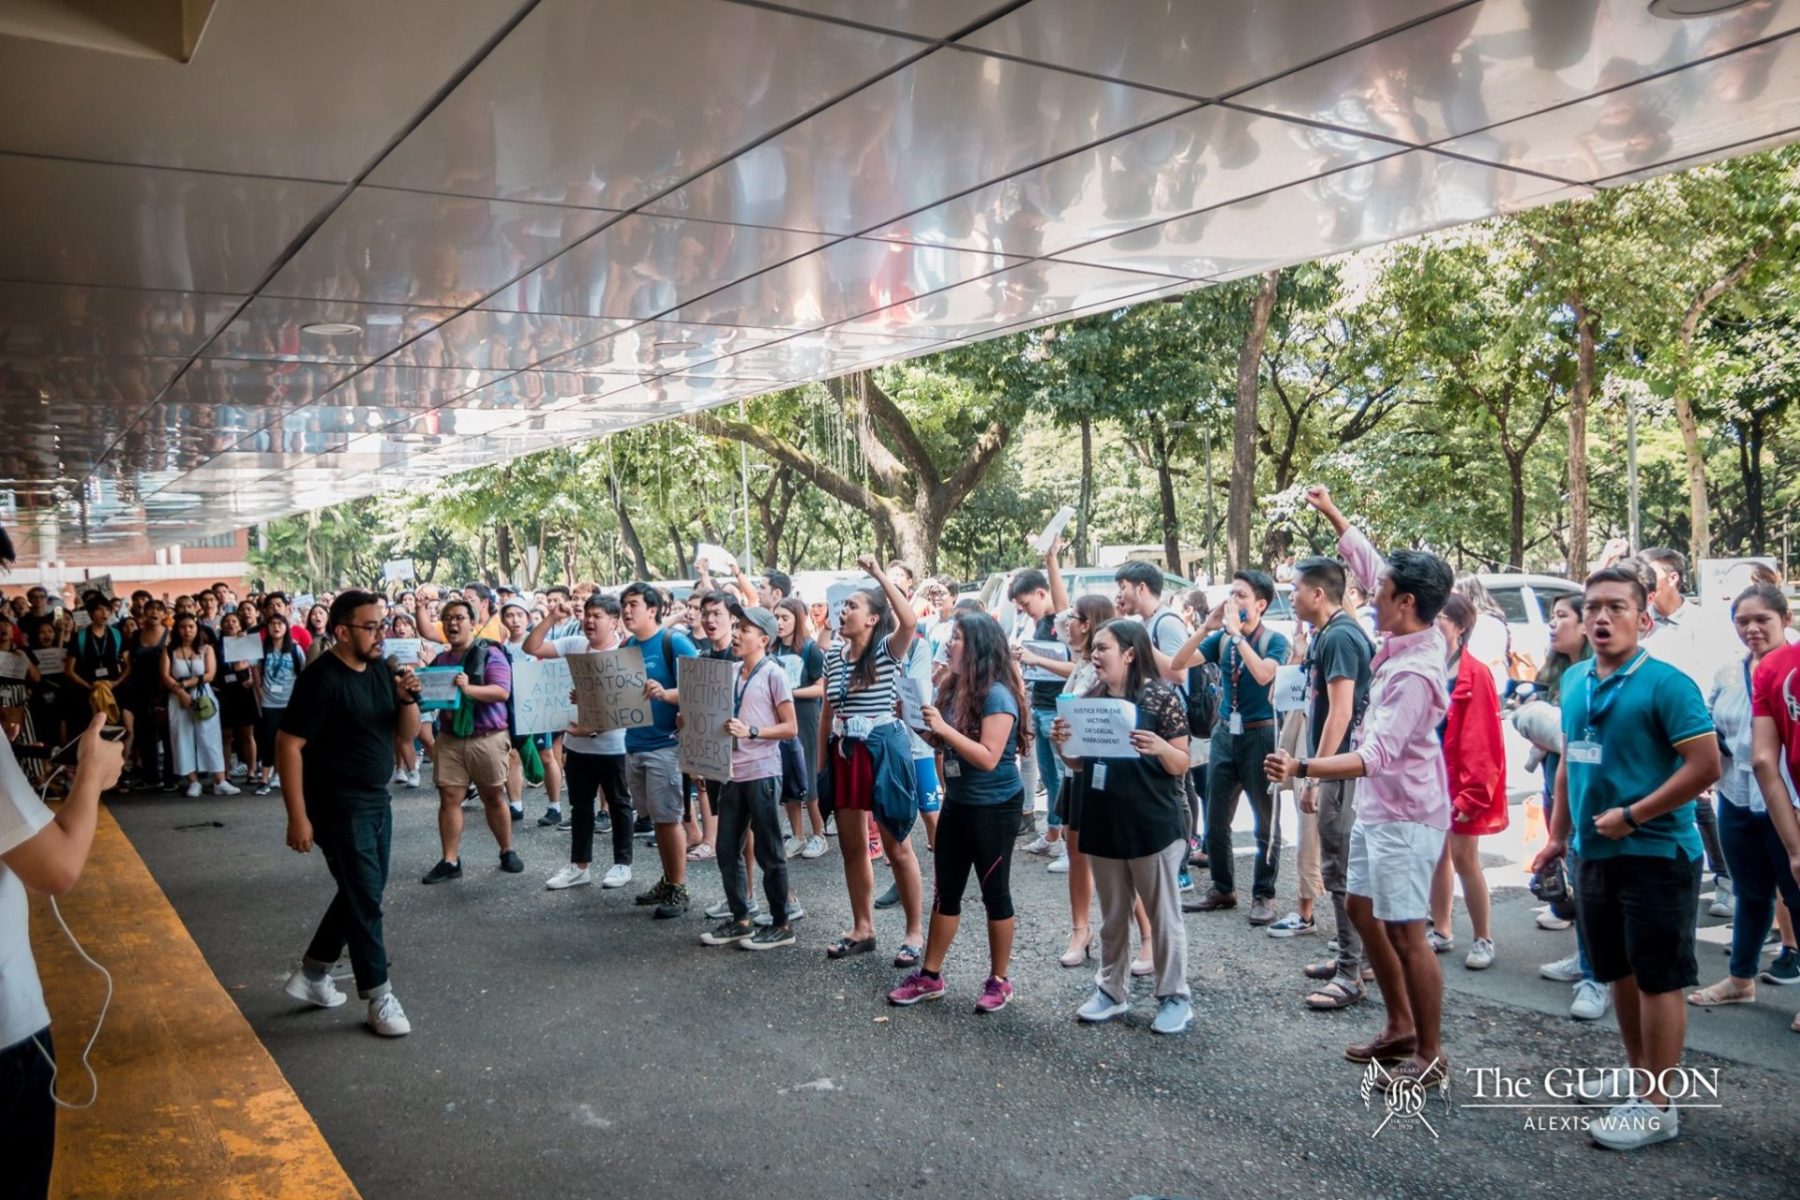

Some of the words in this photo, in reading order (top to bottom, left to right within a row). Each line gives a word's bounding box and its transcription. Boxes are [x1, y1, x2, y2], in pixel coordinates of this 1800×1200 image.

[681, 657, 730, 685] PROTECT
[681, 682, 731, 711] VICTIMS
[688, 710, 717, 735] NOT
